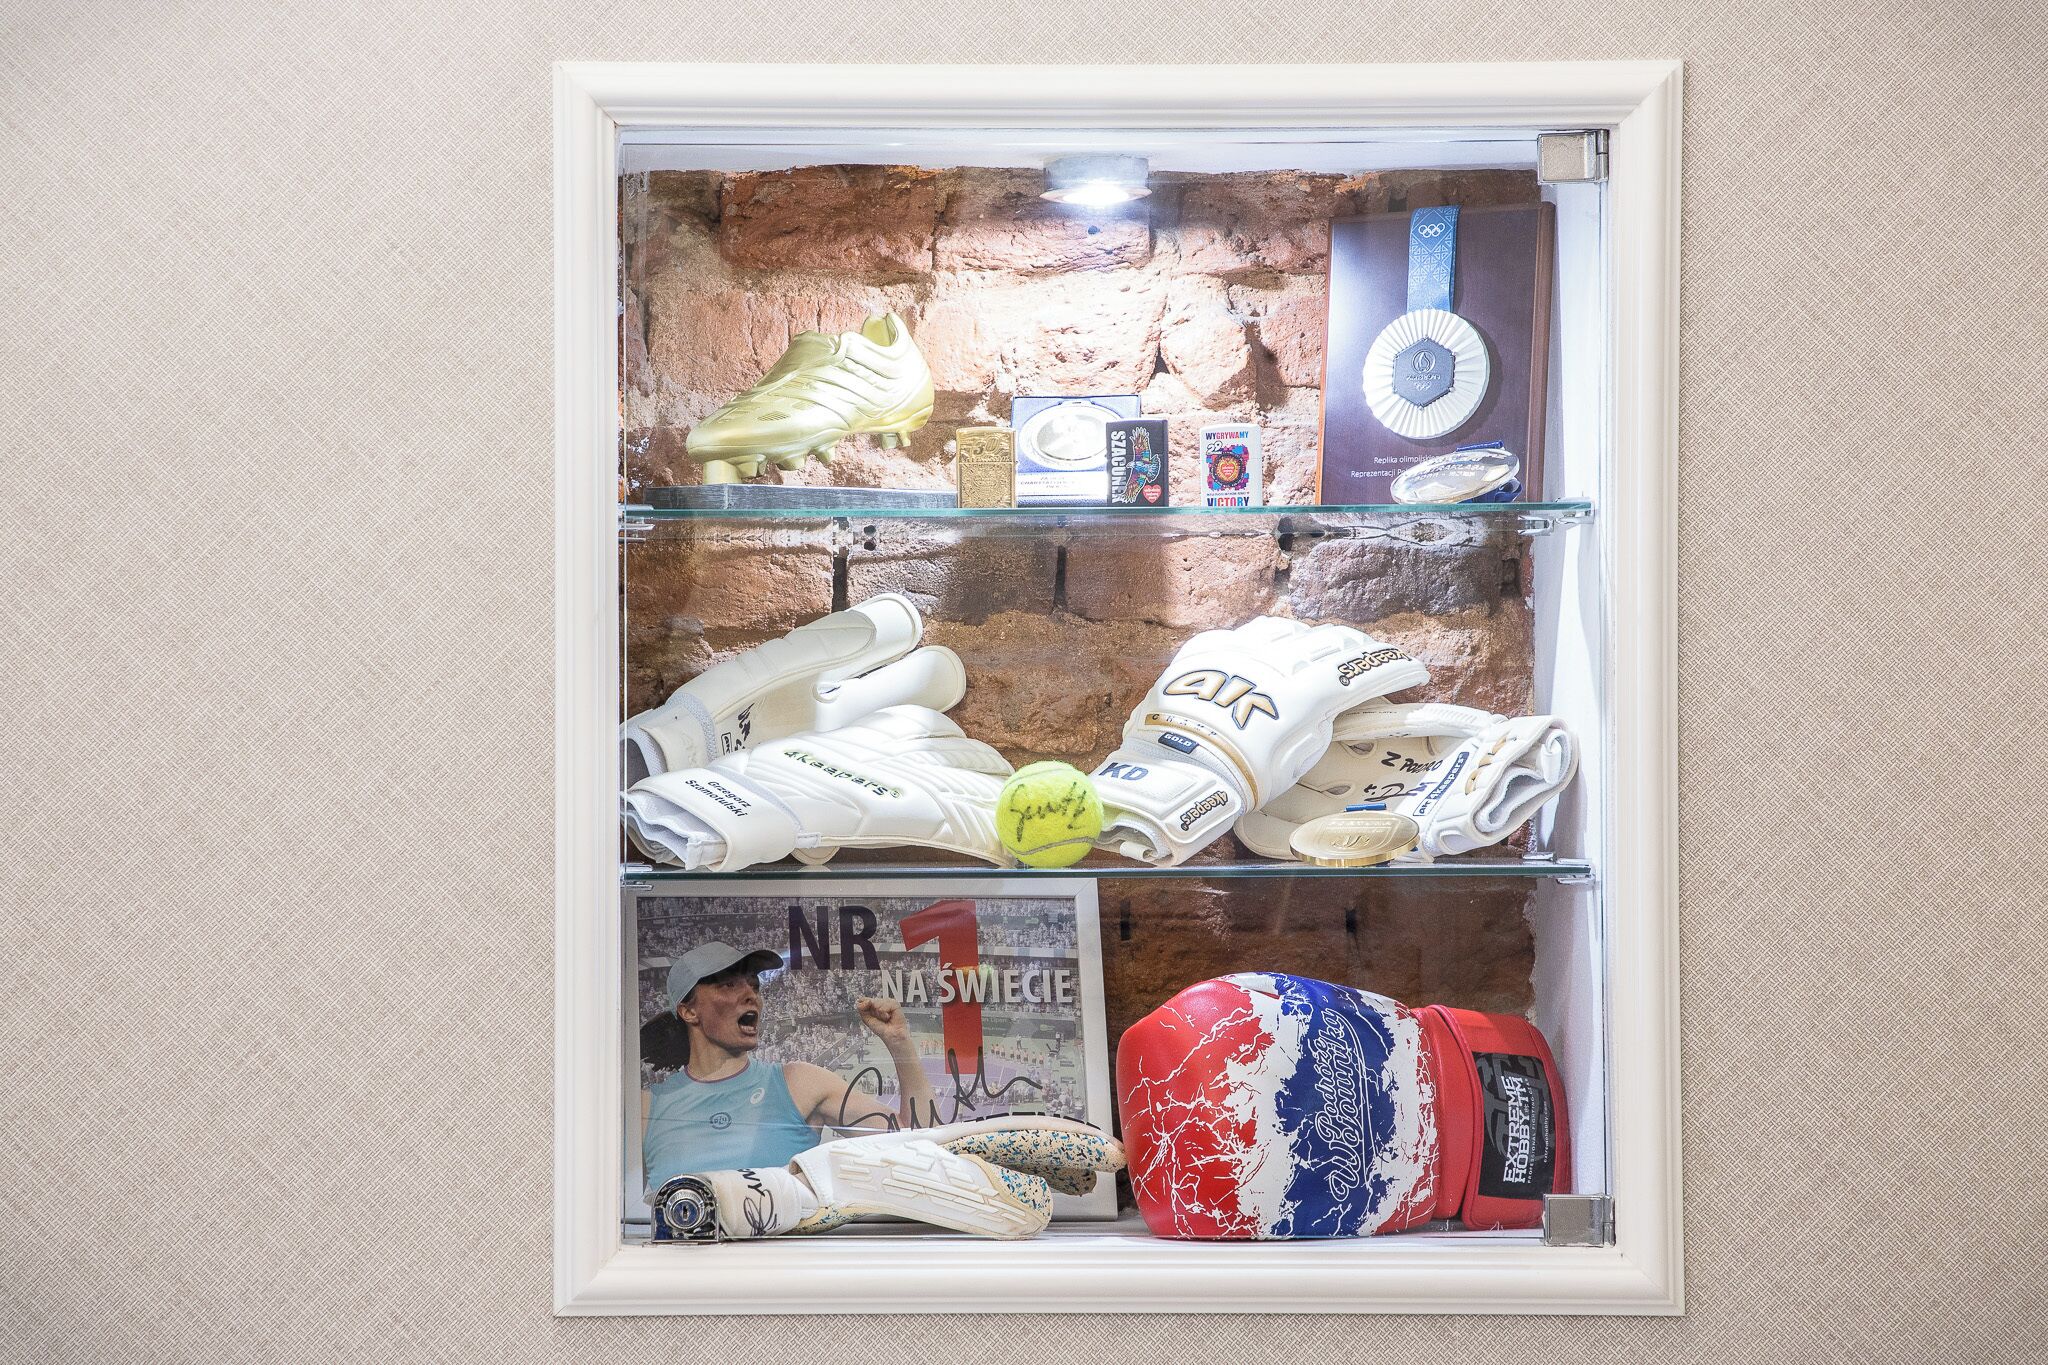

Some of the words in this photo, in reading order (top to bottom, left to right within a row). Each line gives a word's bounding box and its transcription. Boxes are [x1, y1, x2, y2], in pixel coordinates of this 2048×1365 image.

[1205, 431, 1249, 440] WYGRYWAMY
[1111, 430, 1127, 504] SZACUNEK
[1350, 468, 1396, 479] Reprezentacji
[1373, 456, 1398, 465] Replika
[1207, 496, 1250, 507] VICTORY
[1337, 648, 1413, 680] keepers
[1164, 733, 1193, 748] GOLD
[1099, 762, 1149, 781] KD
[685, 779, 748, 817] Szamotulski
[707, 781, 752, 808] Grzegorz
[788, 905, 881, 970] NR
[900, 900, 983, 1075] 1
[881, 969, 929, 1003] NA
[936, 962, 1074, 1003] ŚWIECIE
[1314, 1036, 1342, 1143] Podróże
[1321, 1009, 1363, 1202] Wojownika
[1501, 1076, 1521, 1183] EXTREME
[1514, 1109, 1530, 1184] HOBBY
[1527, 1132, 1536, 1184] PROFESSIONAL
